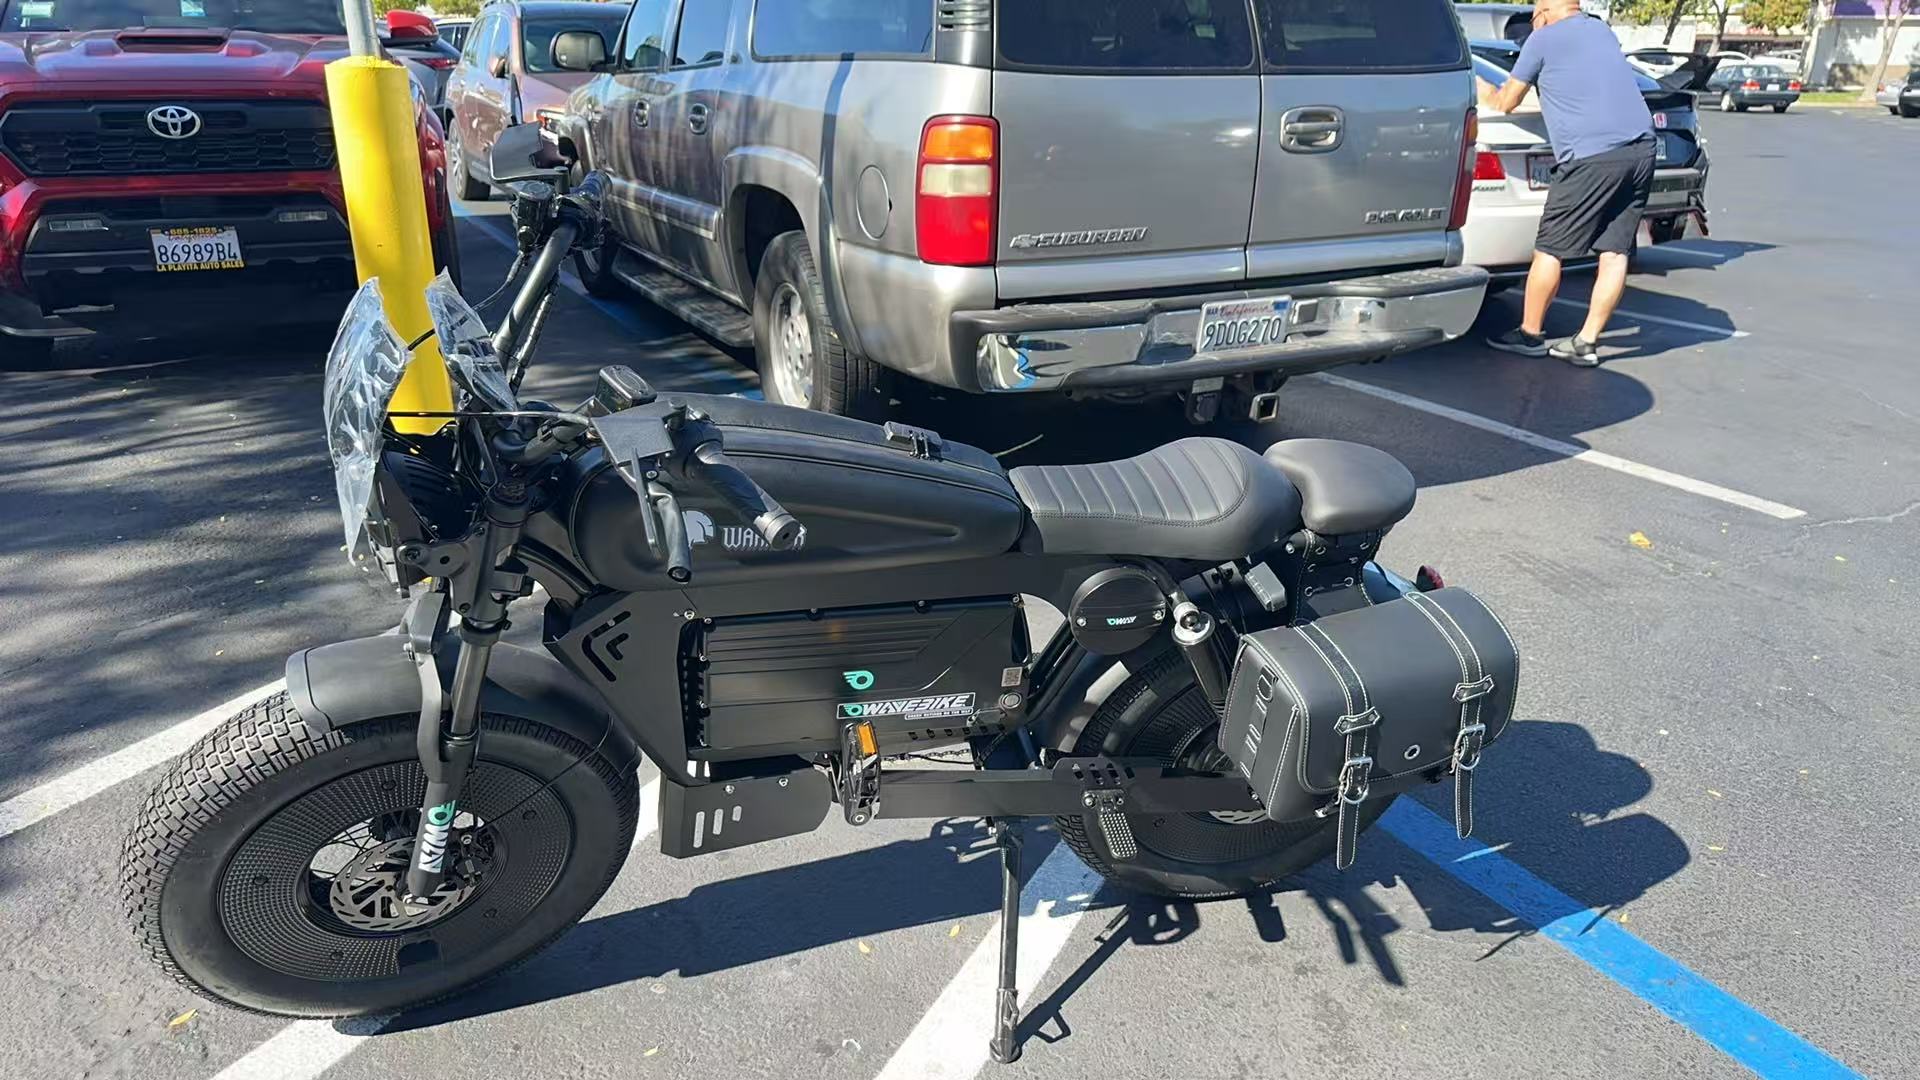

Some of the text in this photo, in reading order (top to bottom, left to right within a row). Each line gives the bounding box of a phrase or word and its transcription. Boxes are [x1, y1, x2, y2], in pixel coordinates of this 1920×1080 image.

[1362, 206, 1447, 224] CHEVROLET
[1037, 226, 1149, 247] SUBURBAN
[157, 242, 238, 263] 86989B4
[156, 260, 245, 272] LA PLAYITA AUTO SALES
